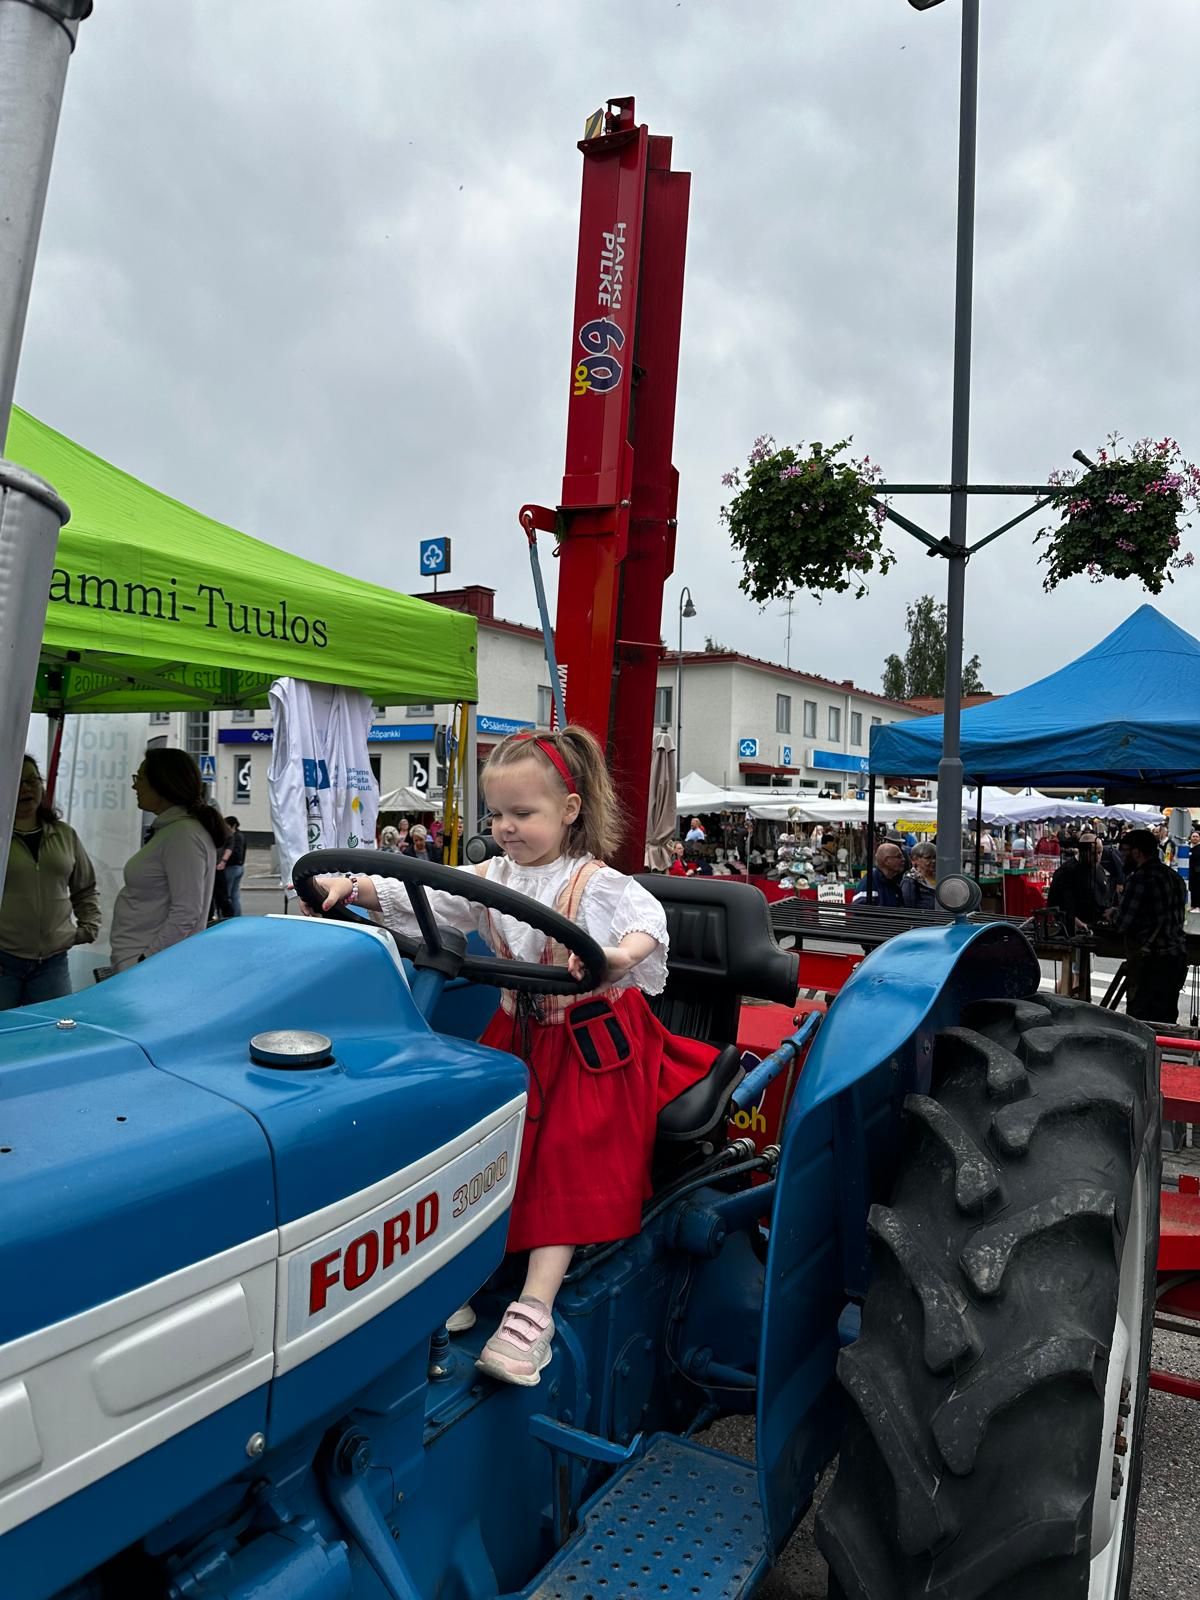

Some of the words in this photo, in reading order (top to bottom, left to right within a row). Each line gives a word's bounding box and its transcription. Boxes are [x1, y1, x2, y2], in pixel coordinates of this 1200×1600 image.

[598, 232, 615, 307] PILKE
[612, 222, 626, 309] HAKKI
[574, 365, 592, 396] oh
[579, 317, 625, 392] 60
[48, 568, 328, 648] ammi-Tuulos
[368, 729, 401, 740] stöpankki
[734, 1105, 767, 1134] oh
[309, 1190, 440, 1317] FORD
[452, 1151, 508, 1218] 3000
